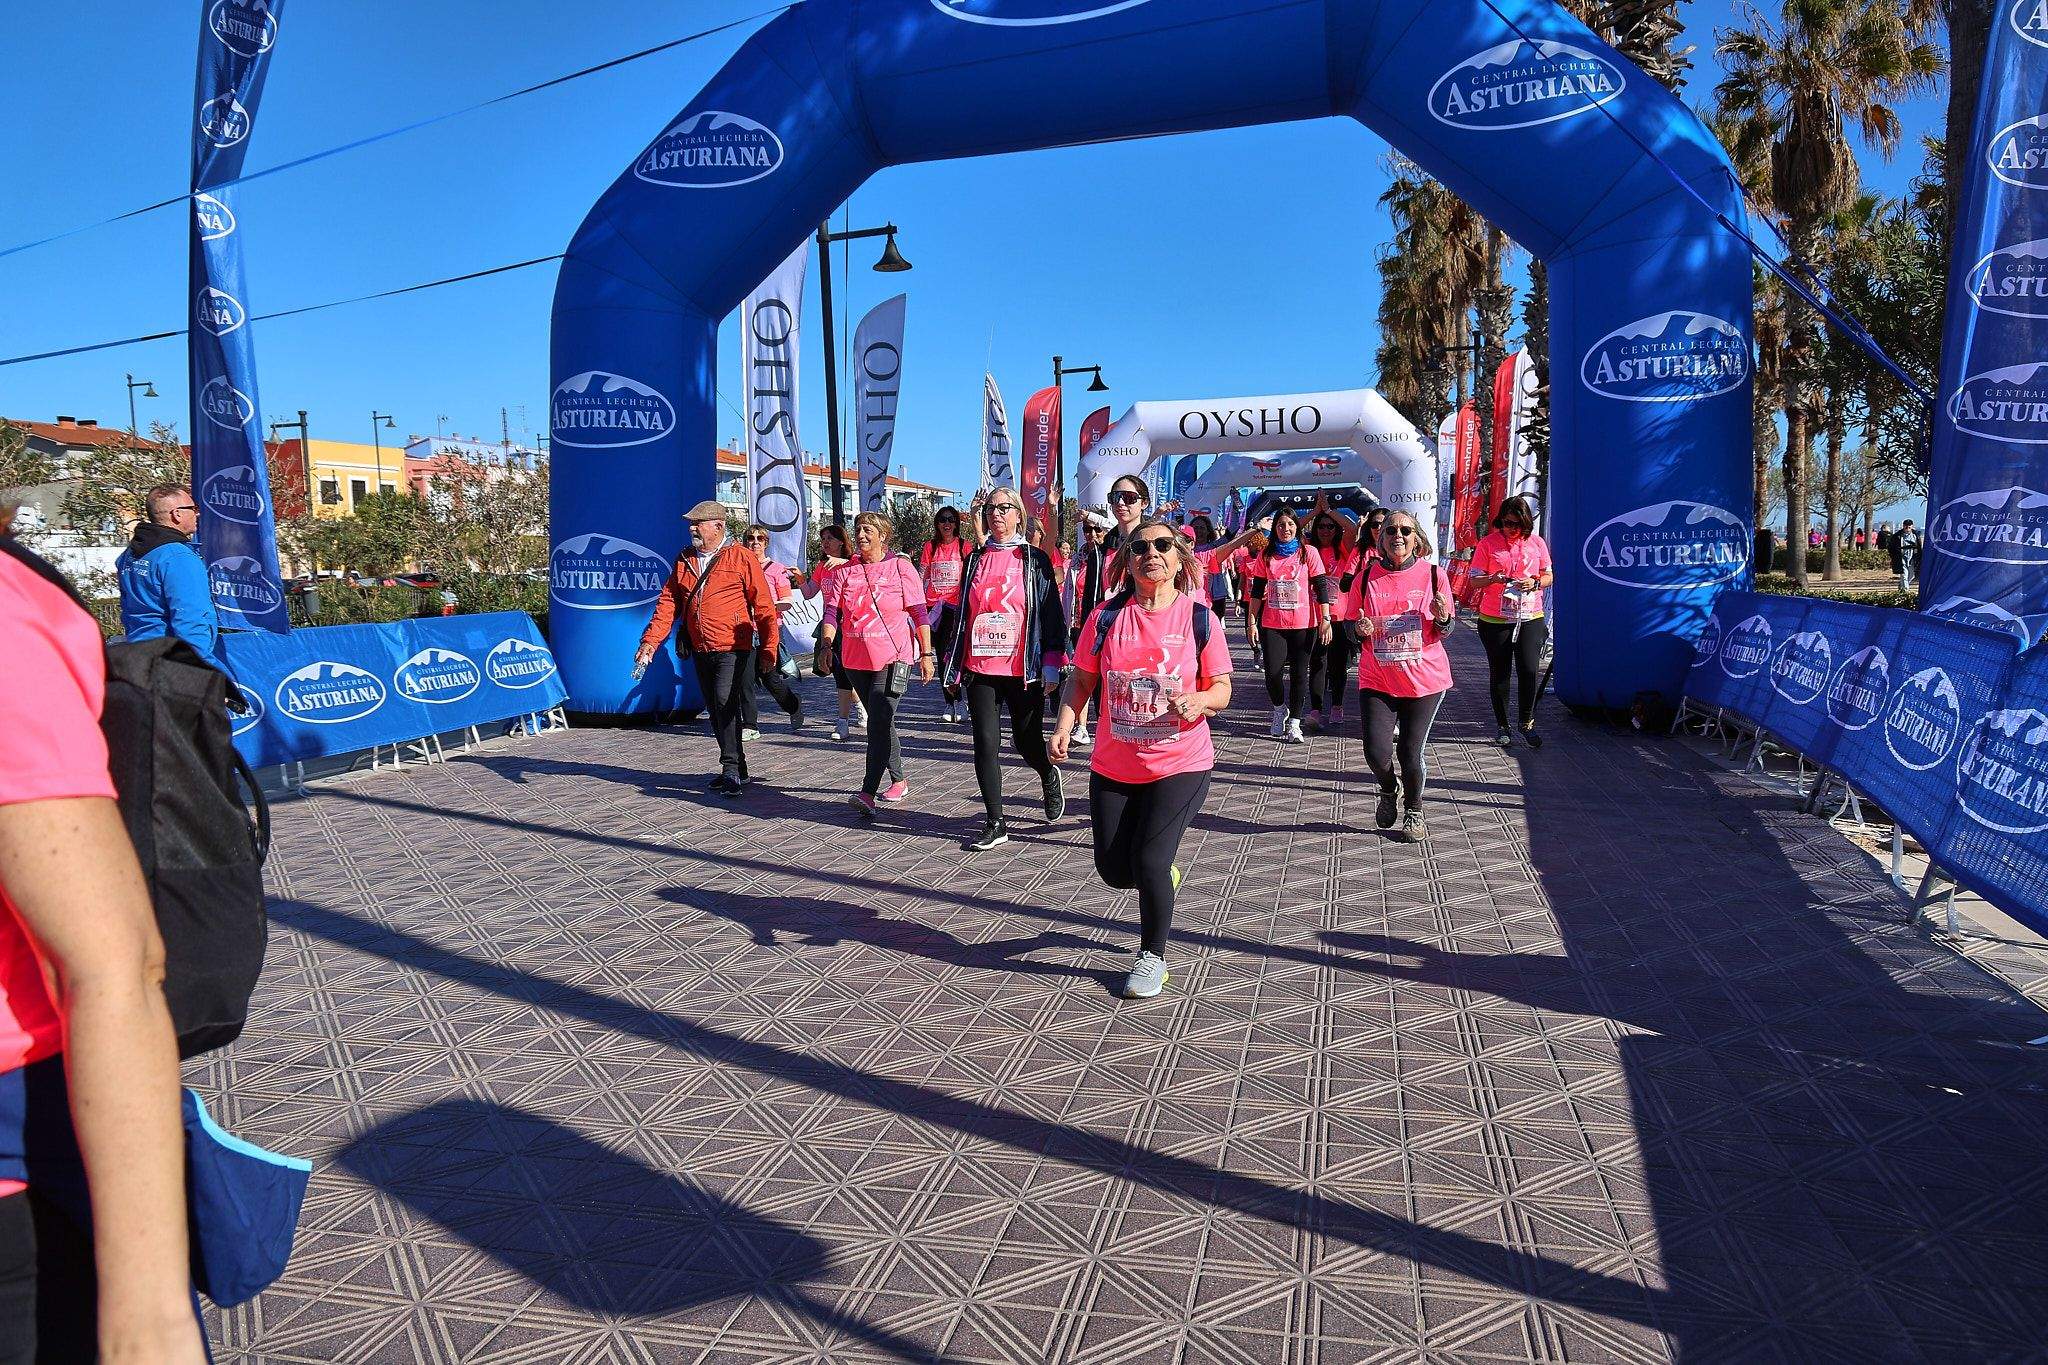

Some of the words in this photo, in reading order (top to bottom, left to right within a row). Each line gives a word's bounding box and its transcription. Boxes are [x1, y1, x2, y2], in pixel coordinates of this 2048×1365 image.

[1472, 67, 1536, 85] CENTRAL
[1542, 62, 1604, 73] LECHERA
[1444, 73, 1615, 117] ASTURIANA
[664, 136, 708, 149] CENTRAL
[713, 134, 765, 142] LECHERA
[640, 146, 772, 173] ASTURIANA
[1621, 341, 1685, 355] CENTRAL
[1593, 350, 1744, 385] ASTURIANA
[561, 397, 602, 406] CENTRAL
[606, 397, 661, 408] LECHERA
[552, 402, 665, 431] ASTURIANA
[752, 298, 801, 533] OYSHO
[1178, 404, 1322, 441] OYSHO
[1034, 408, 1050, 484] Santander
[1364, 432, 1409, 444] OYSHO
[1098, 446, 1139, 457] OYSHO
[1279, 494, 1342, 503] VOLO
[1389, 492, 1432, 504] OYSHO
[1622, 530, 1685, 542] CENTRAL
[1691, 528, 1741, 538] LECHERA
[1936, 513, 2048, 550] ASTURIA
[1595, 535, 1744, 568] ASTURIANA
[561, 559, 601, 567] CENTRAL
[606, 560, 658, 569] LECHERA
[552, 561, 662, 591] ASTURIANA
[988, 632, 1007, 640] 016
[1387, 635, 1406, 643] 016
[493, 657, 552, 680] ASTURIANA
[299, 682, 336, 692] CENTRAL
[337, 678, 372, 687] LECHERA
[405, 670, 477, 695] ASTURIANA
[287, 685, 381, 713] ASTURIANA
[1131, 702, 1158, 713] 016
